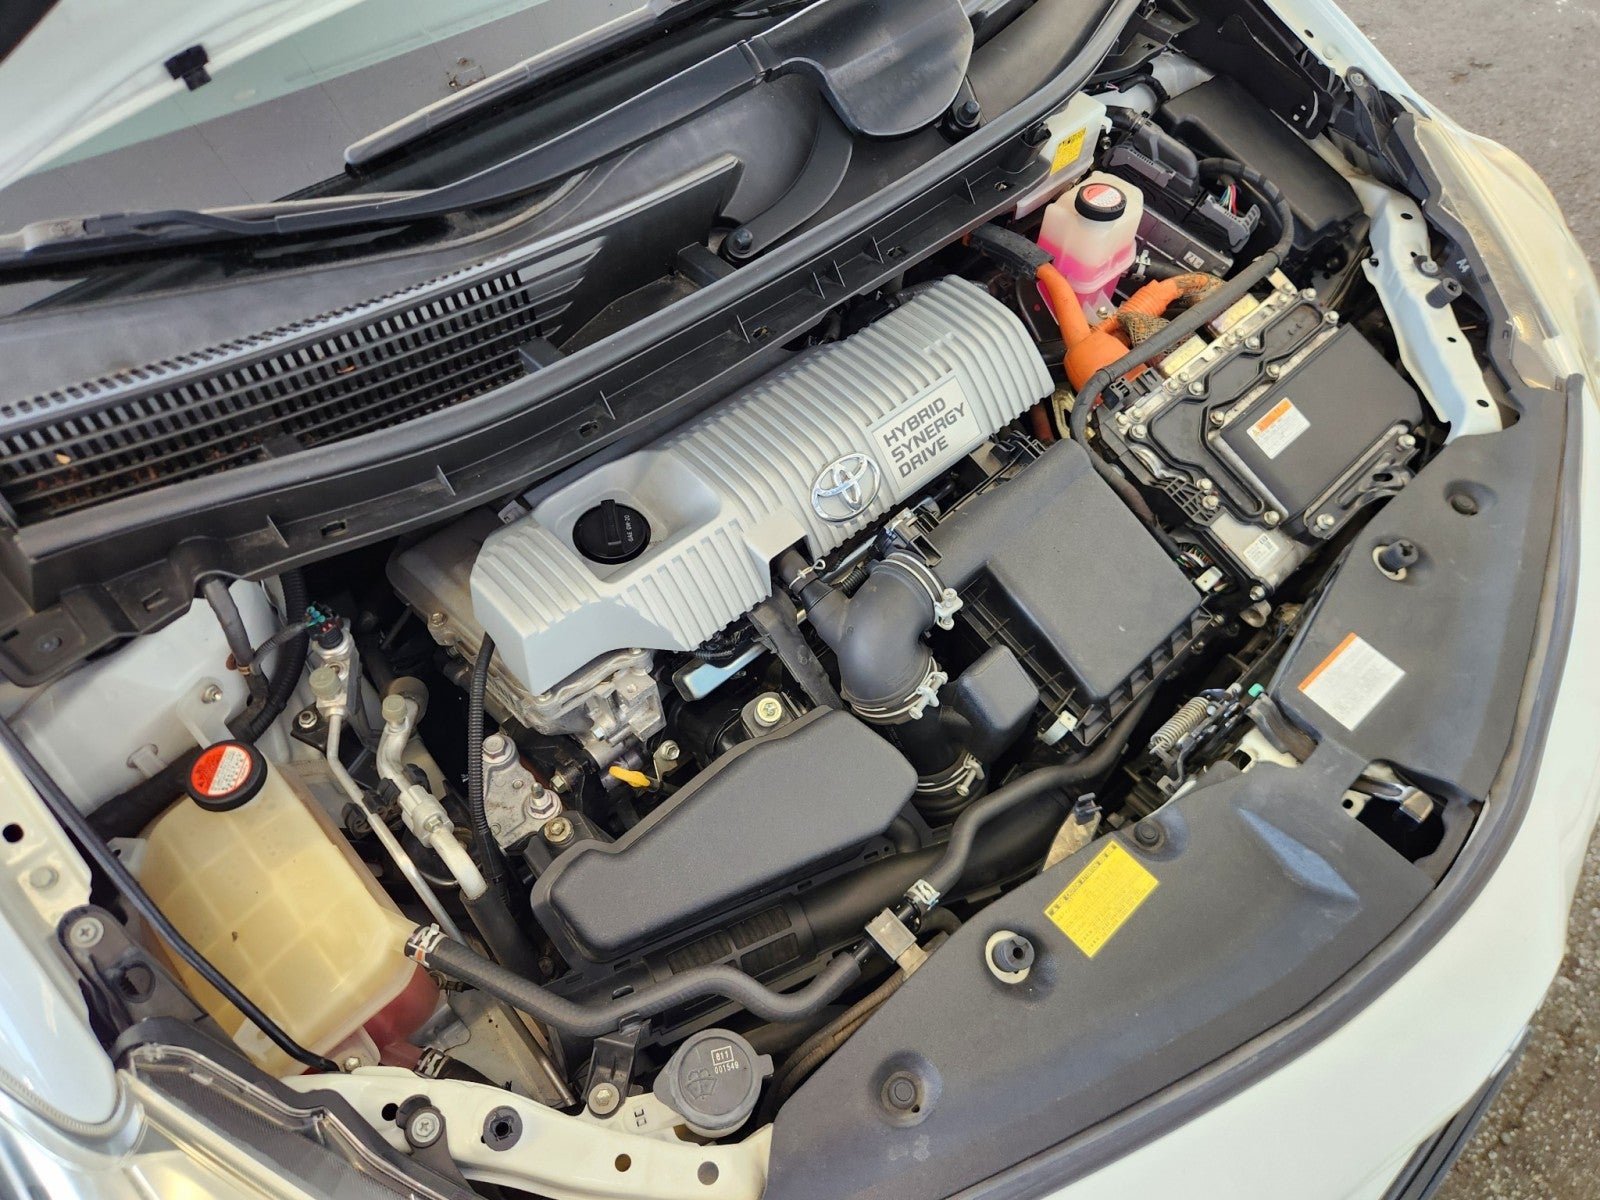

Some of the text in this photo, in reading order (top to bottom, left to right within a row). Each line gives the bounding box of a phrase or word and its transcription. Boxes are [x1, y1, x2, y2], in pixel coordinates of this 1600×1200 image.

[883, 397, 946, 447] HYBRID
[891, 402, 965, 463] SYNERGY
[898, 435, 949, 478] DRIVE
[714, 1060, 739, 1074] 001549
